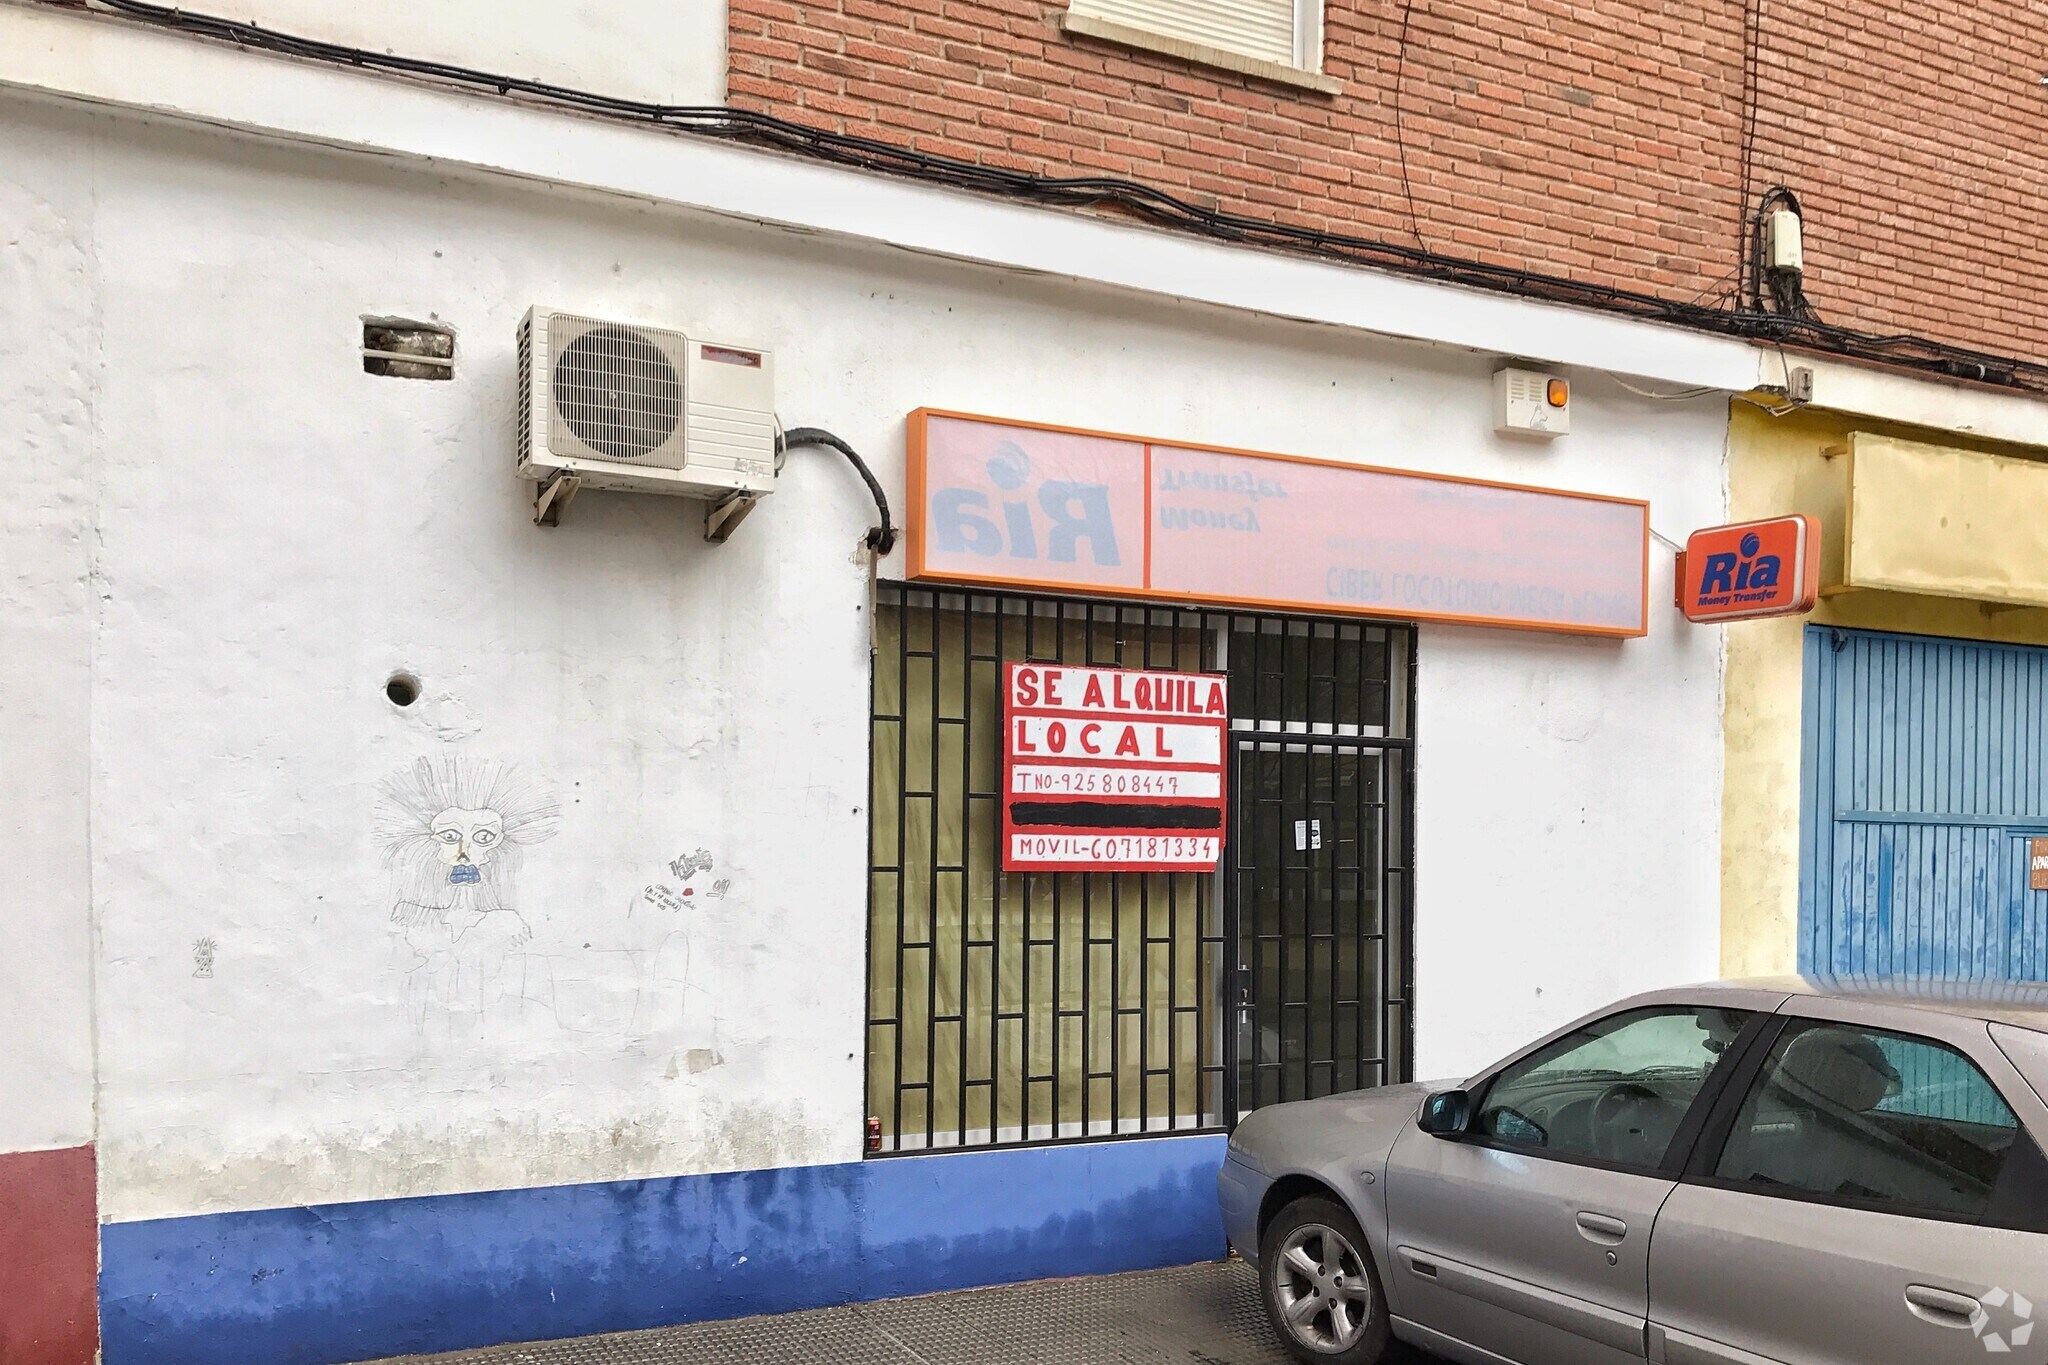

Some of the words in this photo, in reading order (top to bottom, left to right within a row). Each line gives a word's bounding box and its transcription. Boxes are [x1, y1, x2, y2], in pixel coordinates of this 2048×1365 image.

[1700, 533, 1781, 595] Ria
[1698, 595, 1731, 606] Money
[1734, 589, 1778, 602] Transfer
[1016, 668, 1063, 706] SE
[1082, 673, 1225, 715] ALQUILA
[1018, 719, 1173, 757] LOCAL
